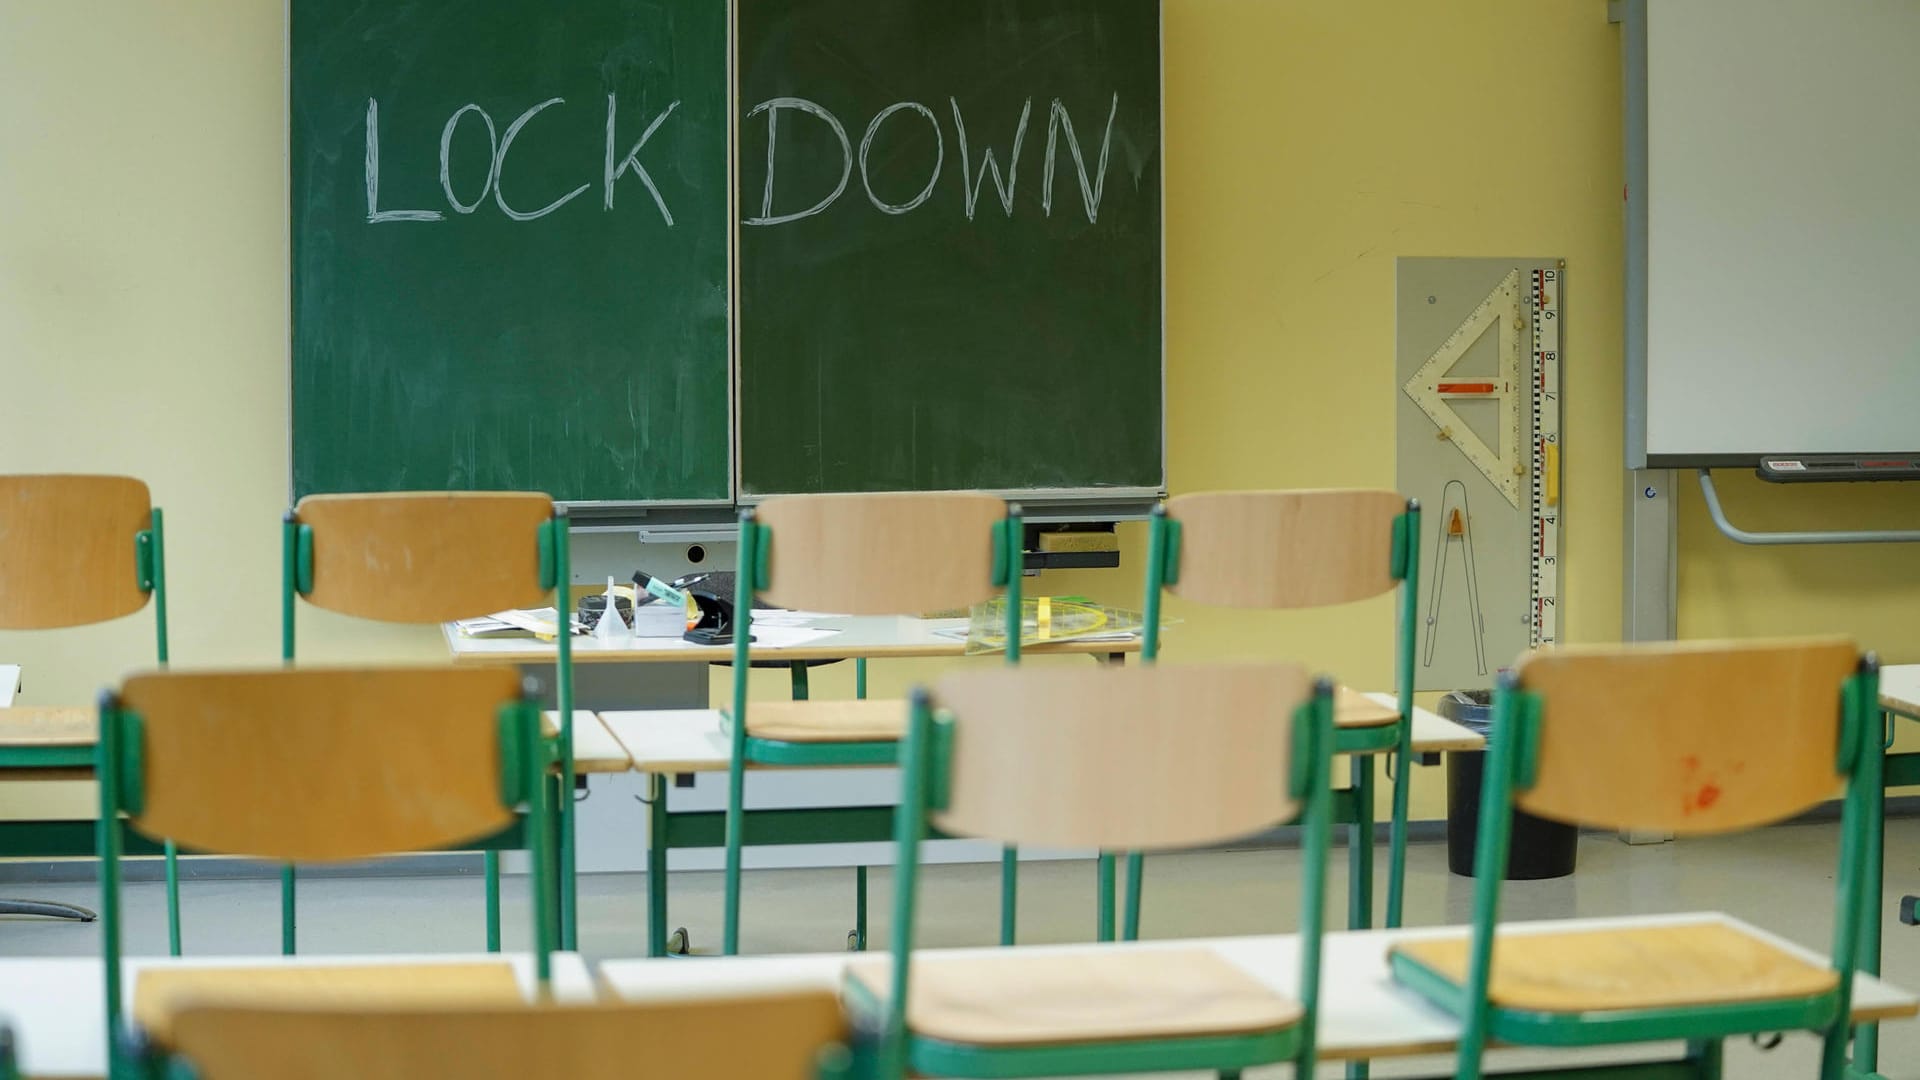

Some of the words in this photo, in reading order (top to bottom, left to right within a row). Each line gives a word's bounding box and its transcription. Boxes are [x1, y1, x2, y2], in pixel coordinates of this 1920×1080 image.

[365, 91, 681, 226] LOCK
[741, 91, 1119, 225] DOWN
[1544, 270, 1556, 283] 10
[1545, 311, 1556, 320] 9
[1545, 352, 1556, 361] 8
[1545, 393, 1556, 401] 7
[1546, 433, 1557, 443] 6
[1545, 516, 1556, 525] 4
[1544, 557, 1555, 566] 3
[1544, 598, 1555, 607] 2
